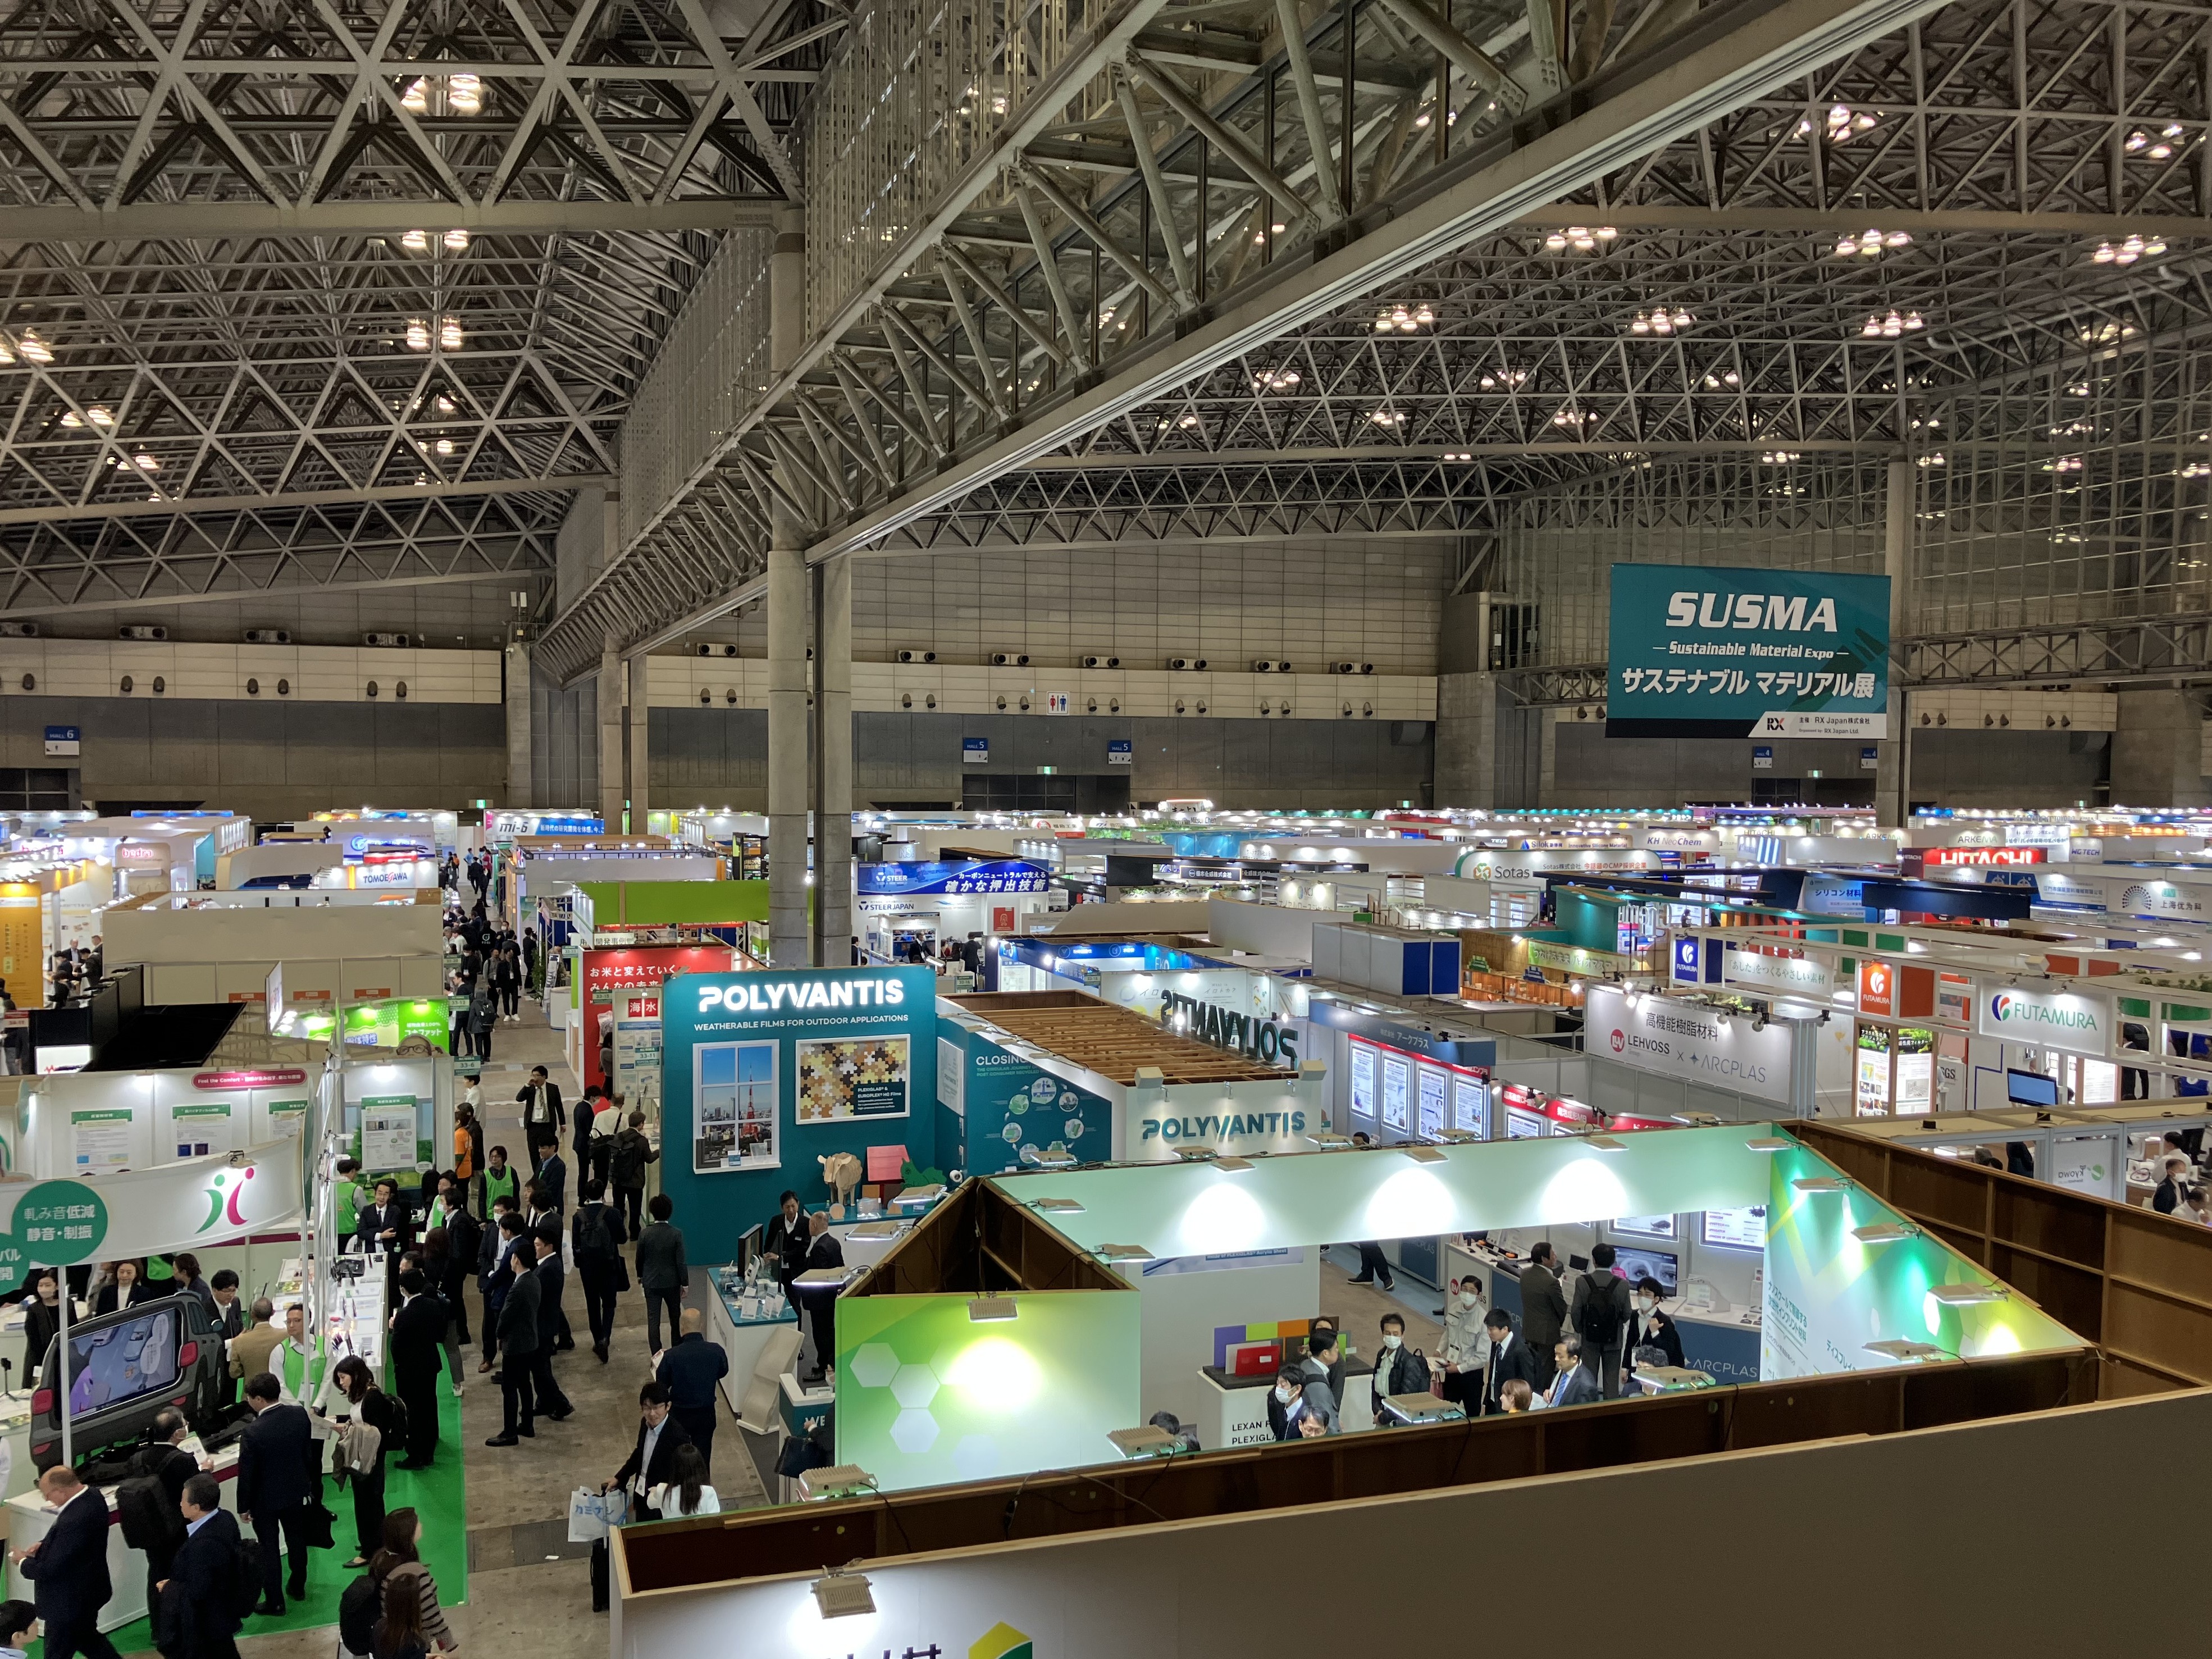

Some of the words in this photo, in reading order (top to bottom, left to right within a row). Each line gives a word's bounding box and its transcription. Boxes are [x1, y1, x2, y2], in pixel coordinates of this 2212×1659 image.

[1666, 591, 1837, 632] SUSMA
[1669, 641, 1745, 656] Sustainable
[1750, 644, 1802, 658] Material
[1804, 648, 1834, 659] Expo
[1622, 668, 1750, 695] サステナブル
[1756, 672, 1875, 699] マテリアル展
[1767, 718, 1785, 731] RX
[1826, 717, 1870, 726] Japan株式会社
[67, 730, 74, 739] 6
[500, 822, 528, 833] mi-6
[1662, 836, 1702, 846] NeoChem
[1941, 851, 2032, 864] HITACHI
[363, 872, 408, 883] TOMOEGAWA
[1495, 865, 1530, 879] Sotas
[945, 879, 1046, 893] 確かな押出技術
[1815, 888, 1862, 897] シリコン材料
[590, 965, 675, 977] お米と変えていく
[1676, 963, 1698, 972] FUTAMURA
[699, 979, 904, 1012] POLYVANTIS
[1863, 994, 1890, 1005] FUTAMURA
[630, 1002, 640, 1013] 海
[646, 1001, 656, 1011] 水
[695, 1020, 758, 1031] WEATHERABLE
[760, 1019, 785, 1028] FILMS
[806, 1017, 849, 1026] OUTDOOR
[850, 1014, 909, 1024] APPLICATIONS
[2014, 1003, 2097, 1031] FUTAMURA
[1646, 1012, 1718, 1042] 高機能樹脂材料
[1397, 1032, 1429, 1050] アークプラス
[1628, 1034, 1670, 1054] LEHVOSS
[1700, 1054, 1766, 1083] ARCPLAS
[1940, 1066, 1955, 1079] SGS
[1142, 1111, 1305, 1140] POLYVANTIS
[24, 1204, 95, 1221] 軋み音低減
[26, 1225, 93, 1242] 静音・制振
[1693, 1358, 1757, 1378] ARCPLAS
[1232, 1421, 1262, 1432] LEXAN
